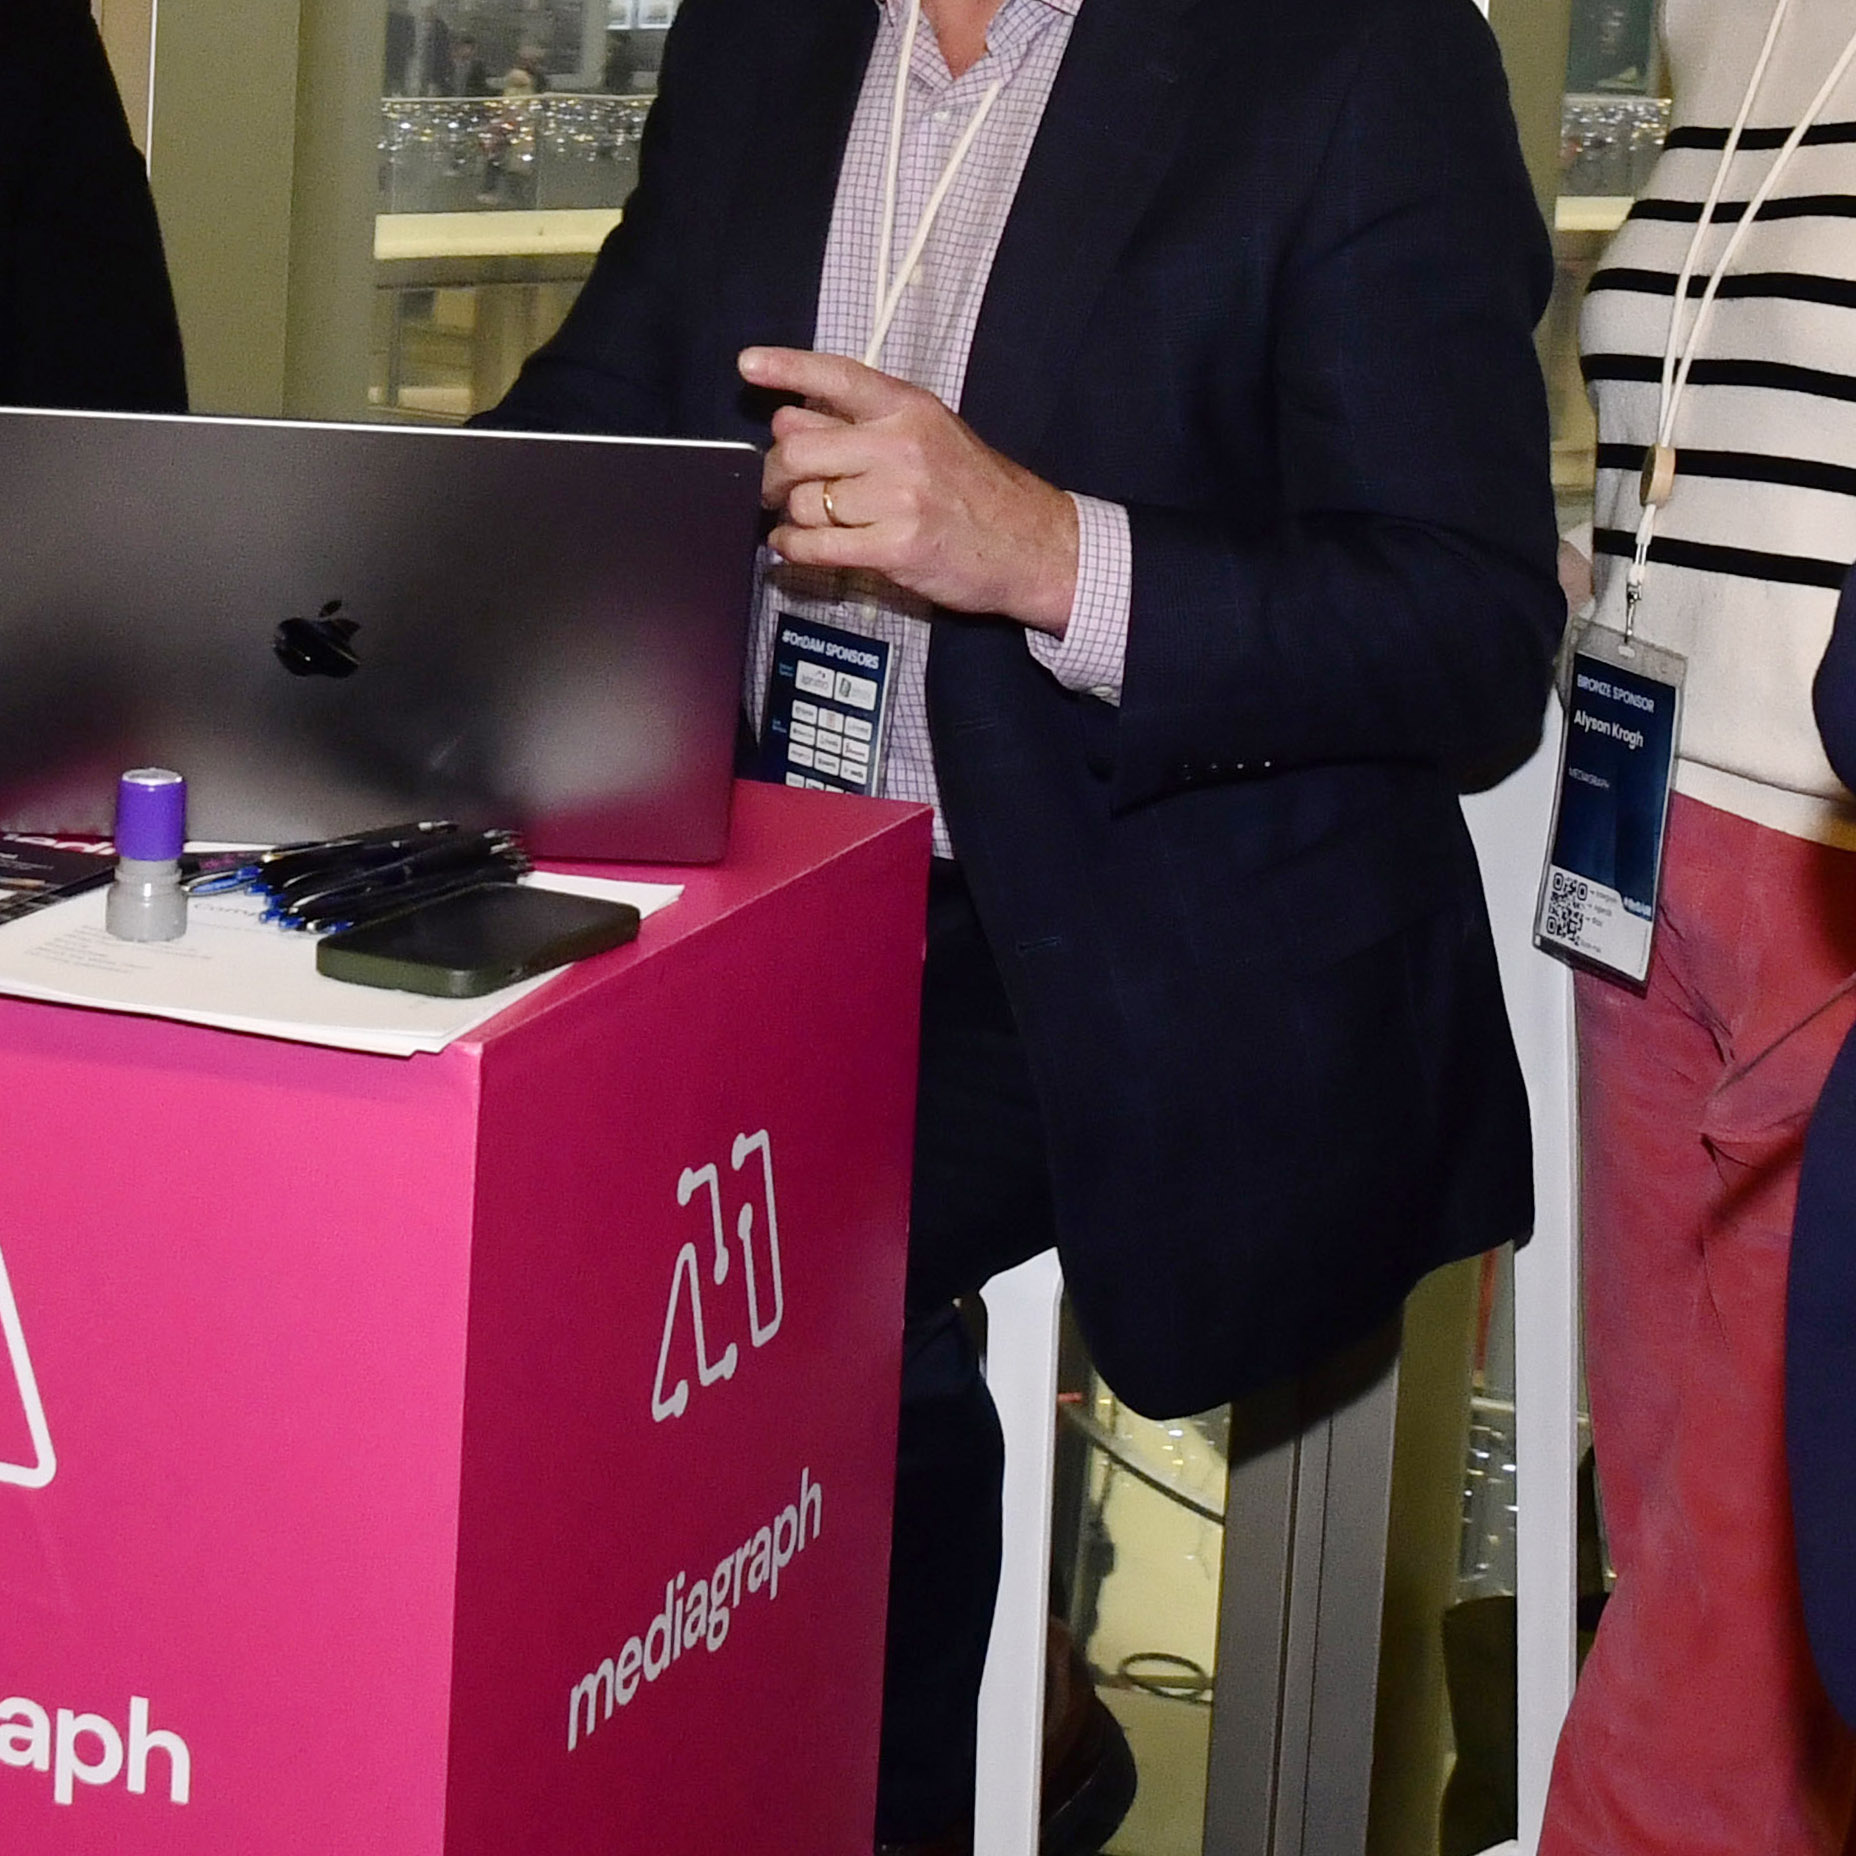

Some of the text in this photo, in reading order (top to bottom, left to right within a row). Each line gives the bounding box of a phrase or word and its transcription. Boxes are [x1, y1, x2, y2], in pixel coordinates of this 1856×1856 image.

[826, 642, 879, 669] SPONSORS
[1577, 673, 1655, 714] BRONZE SPONSOR
[1573, 709, 1644, 750] Alyson Krogh
[567, 1467, 823, 1752] mediagraph
